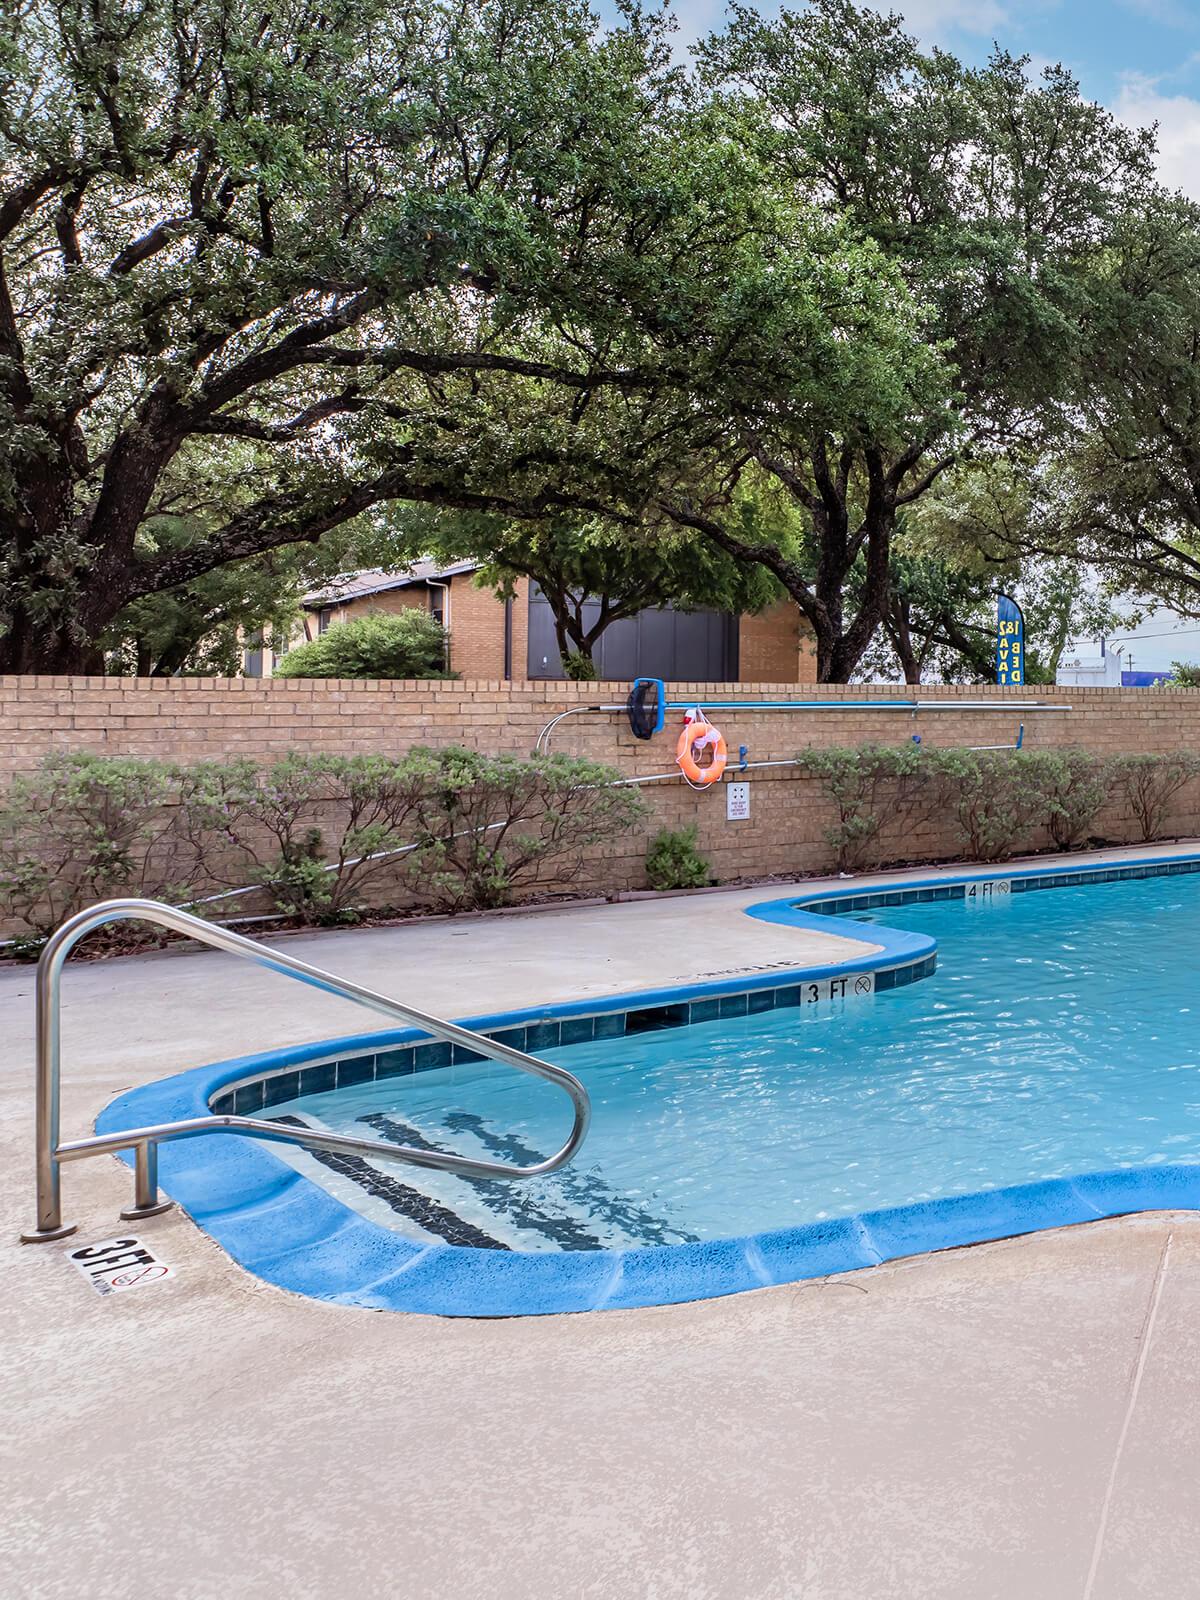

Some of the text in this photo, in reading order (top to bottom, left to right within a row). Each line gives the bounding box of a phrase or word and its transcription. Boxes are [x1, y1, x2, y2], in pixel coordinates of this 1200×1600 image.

[968, 882, 994, 897] 4 FT
[807, 979, 849, 1003] 3 FT
